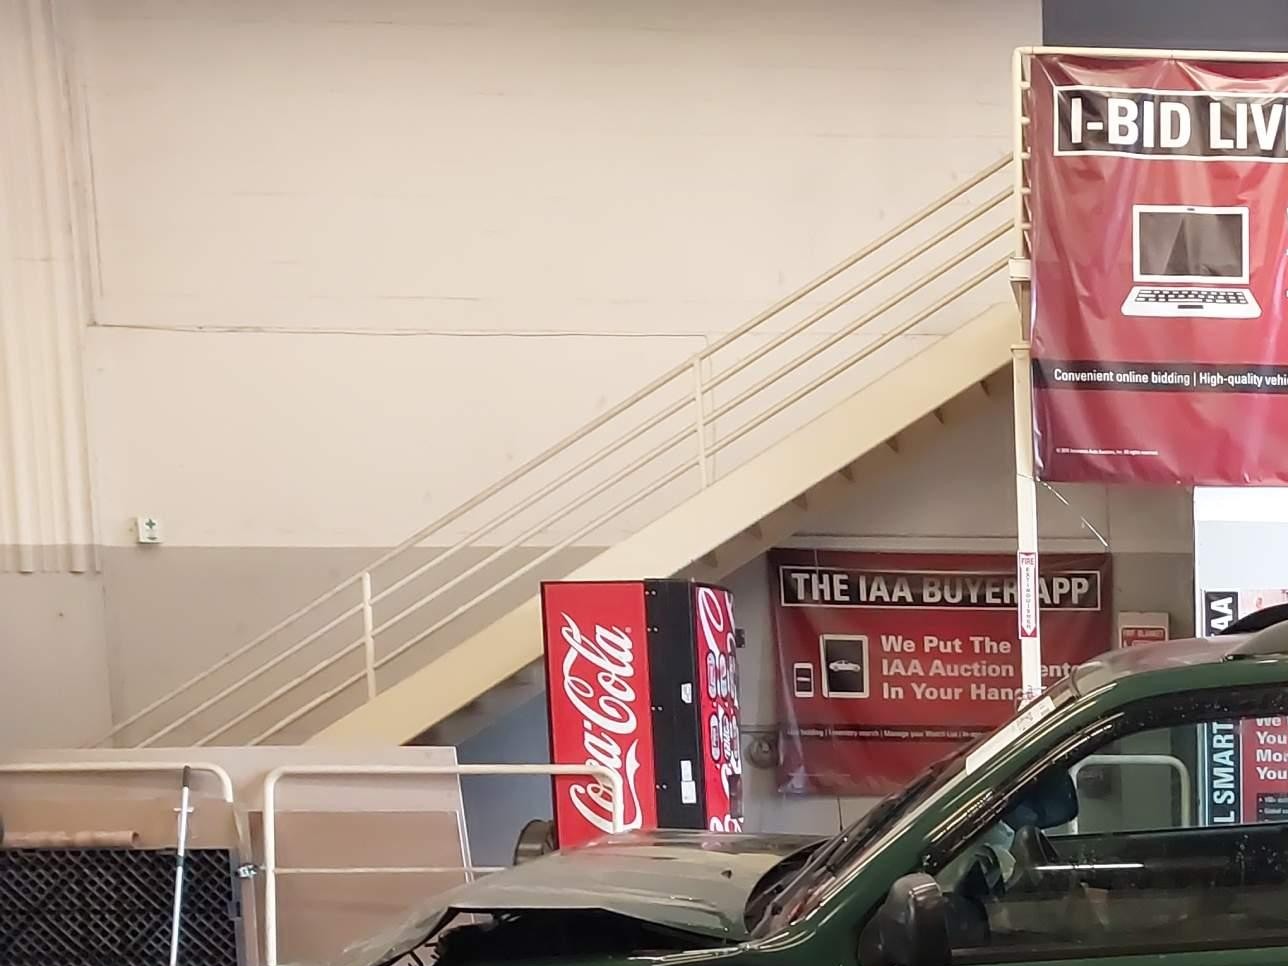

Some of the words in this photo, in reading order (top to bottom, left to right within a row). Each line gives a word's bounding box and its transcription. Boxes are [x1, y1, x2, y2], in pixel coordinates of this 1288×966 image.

[1070, 97, 1191, 149] I-BID
[1054, 368, 1114, 382] Convenient
[1116, 371, 1149, 384] online
[1151, 371, 1190, 387] bidding
[1200, 373, 1263, 388] High-quality
[1021, 557, 1035, 566] FIRE
[792, 573, 850, 601] THE
[859, 575, 914, 603] IAA
[922, 576, 1018, 604] BUYER
[1040, 577, 1089, 604] APP
[1210, 596, 1233, 637] AA
[881, 635, 915, 653] We
[923, 636, 962, 653] Put
[969, 636, 1011, 653] The
[881, 659, 924, 676] IAA
[929, 660, 1014, 677] Auction
[882, 683, 903, 699] In
[911, 683, 960, 700] Your
[1256, 717, 1281, 727] We
[1256, 731, 1287, 745] You
